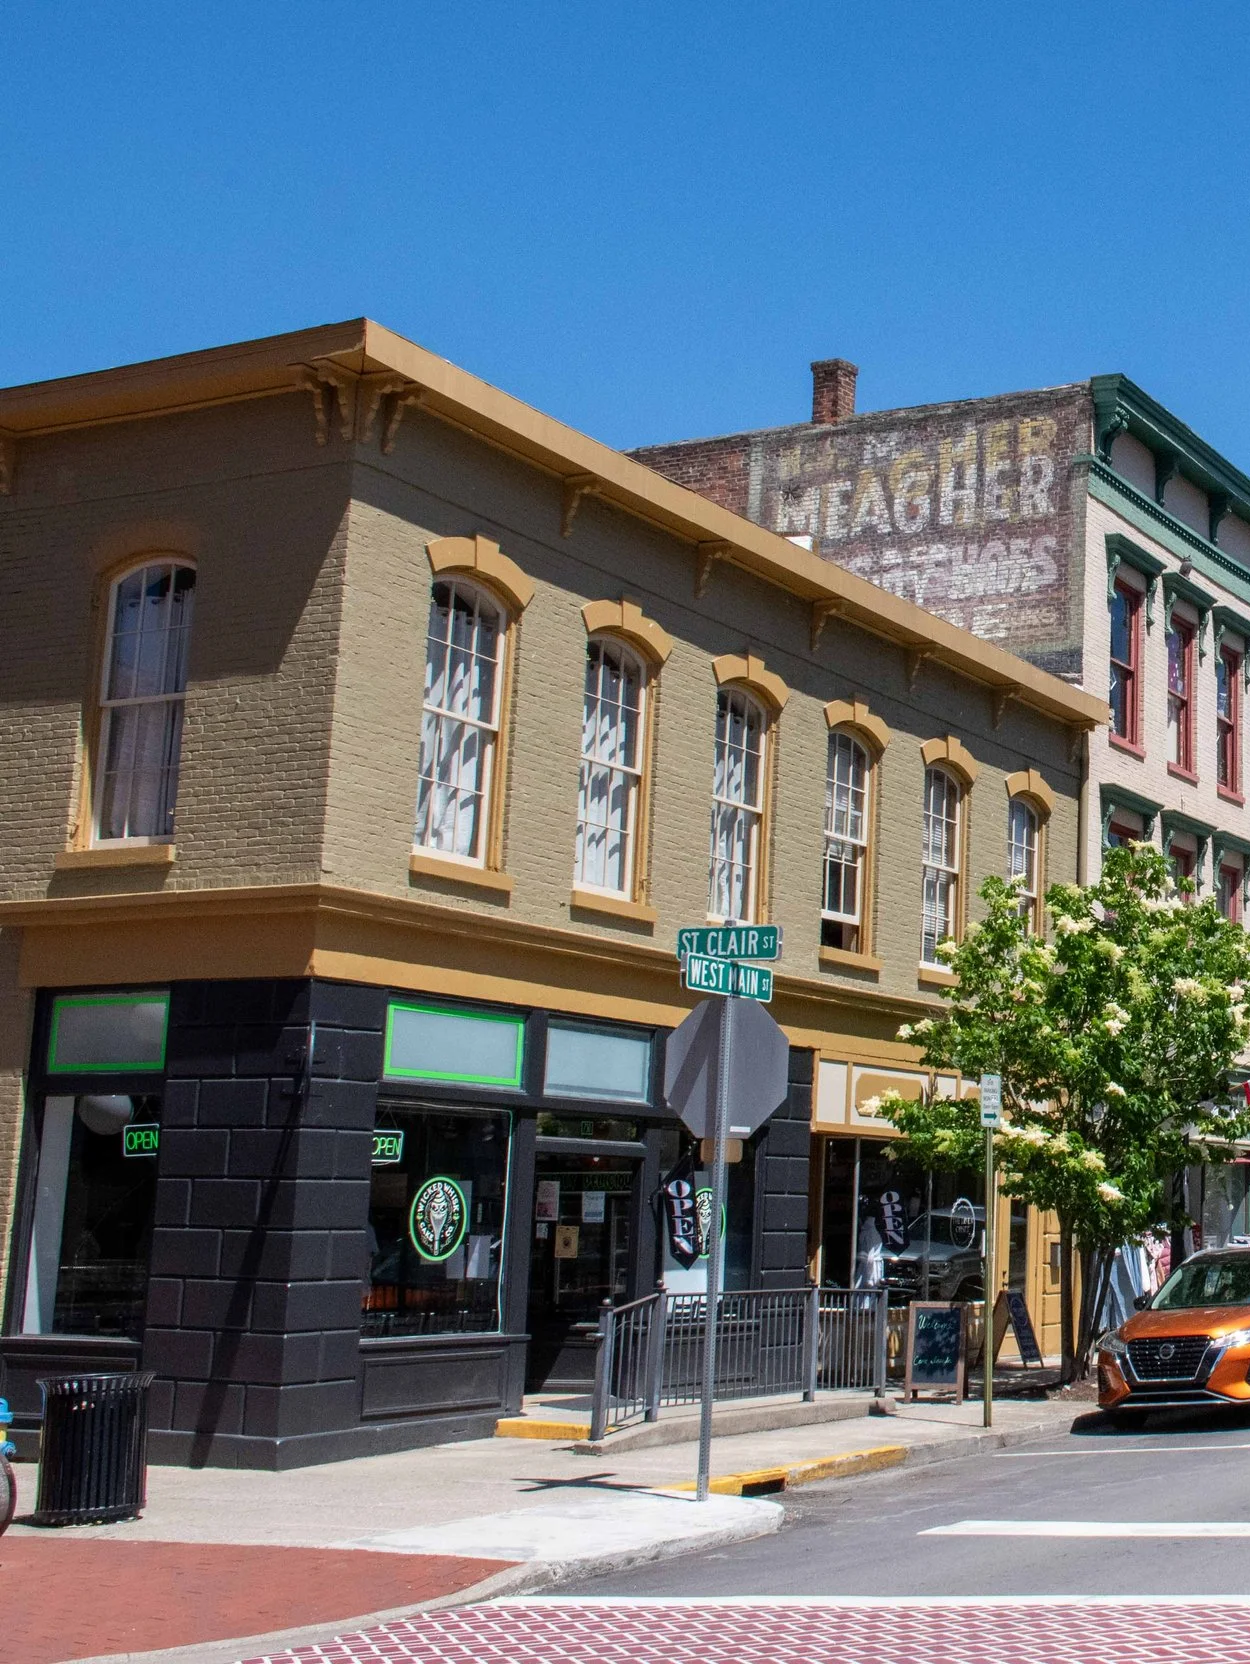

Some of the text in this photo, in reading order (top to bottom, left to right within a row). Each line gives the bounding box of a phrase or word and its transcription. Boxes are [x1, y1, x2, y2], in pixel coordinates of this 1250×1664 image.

[706, 930, 759, 955] CLAIR
[762, 936, 775, 949] ST
[691, 958, 770, 995] WEST MAIN ST
[126, 1131, 158, 1149] OPEN
[417, 1182, 460, 1212] WICKED WHISK
[419, 1221, 434, 1241] CAKE
[667, 1179, 694, 1254] OPEN
[880, 1190, 905, 1245] OPEN
